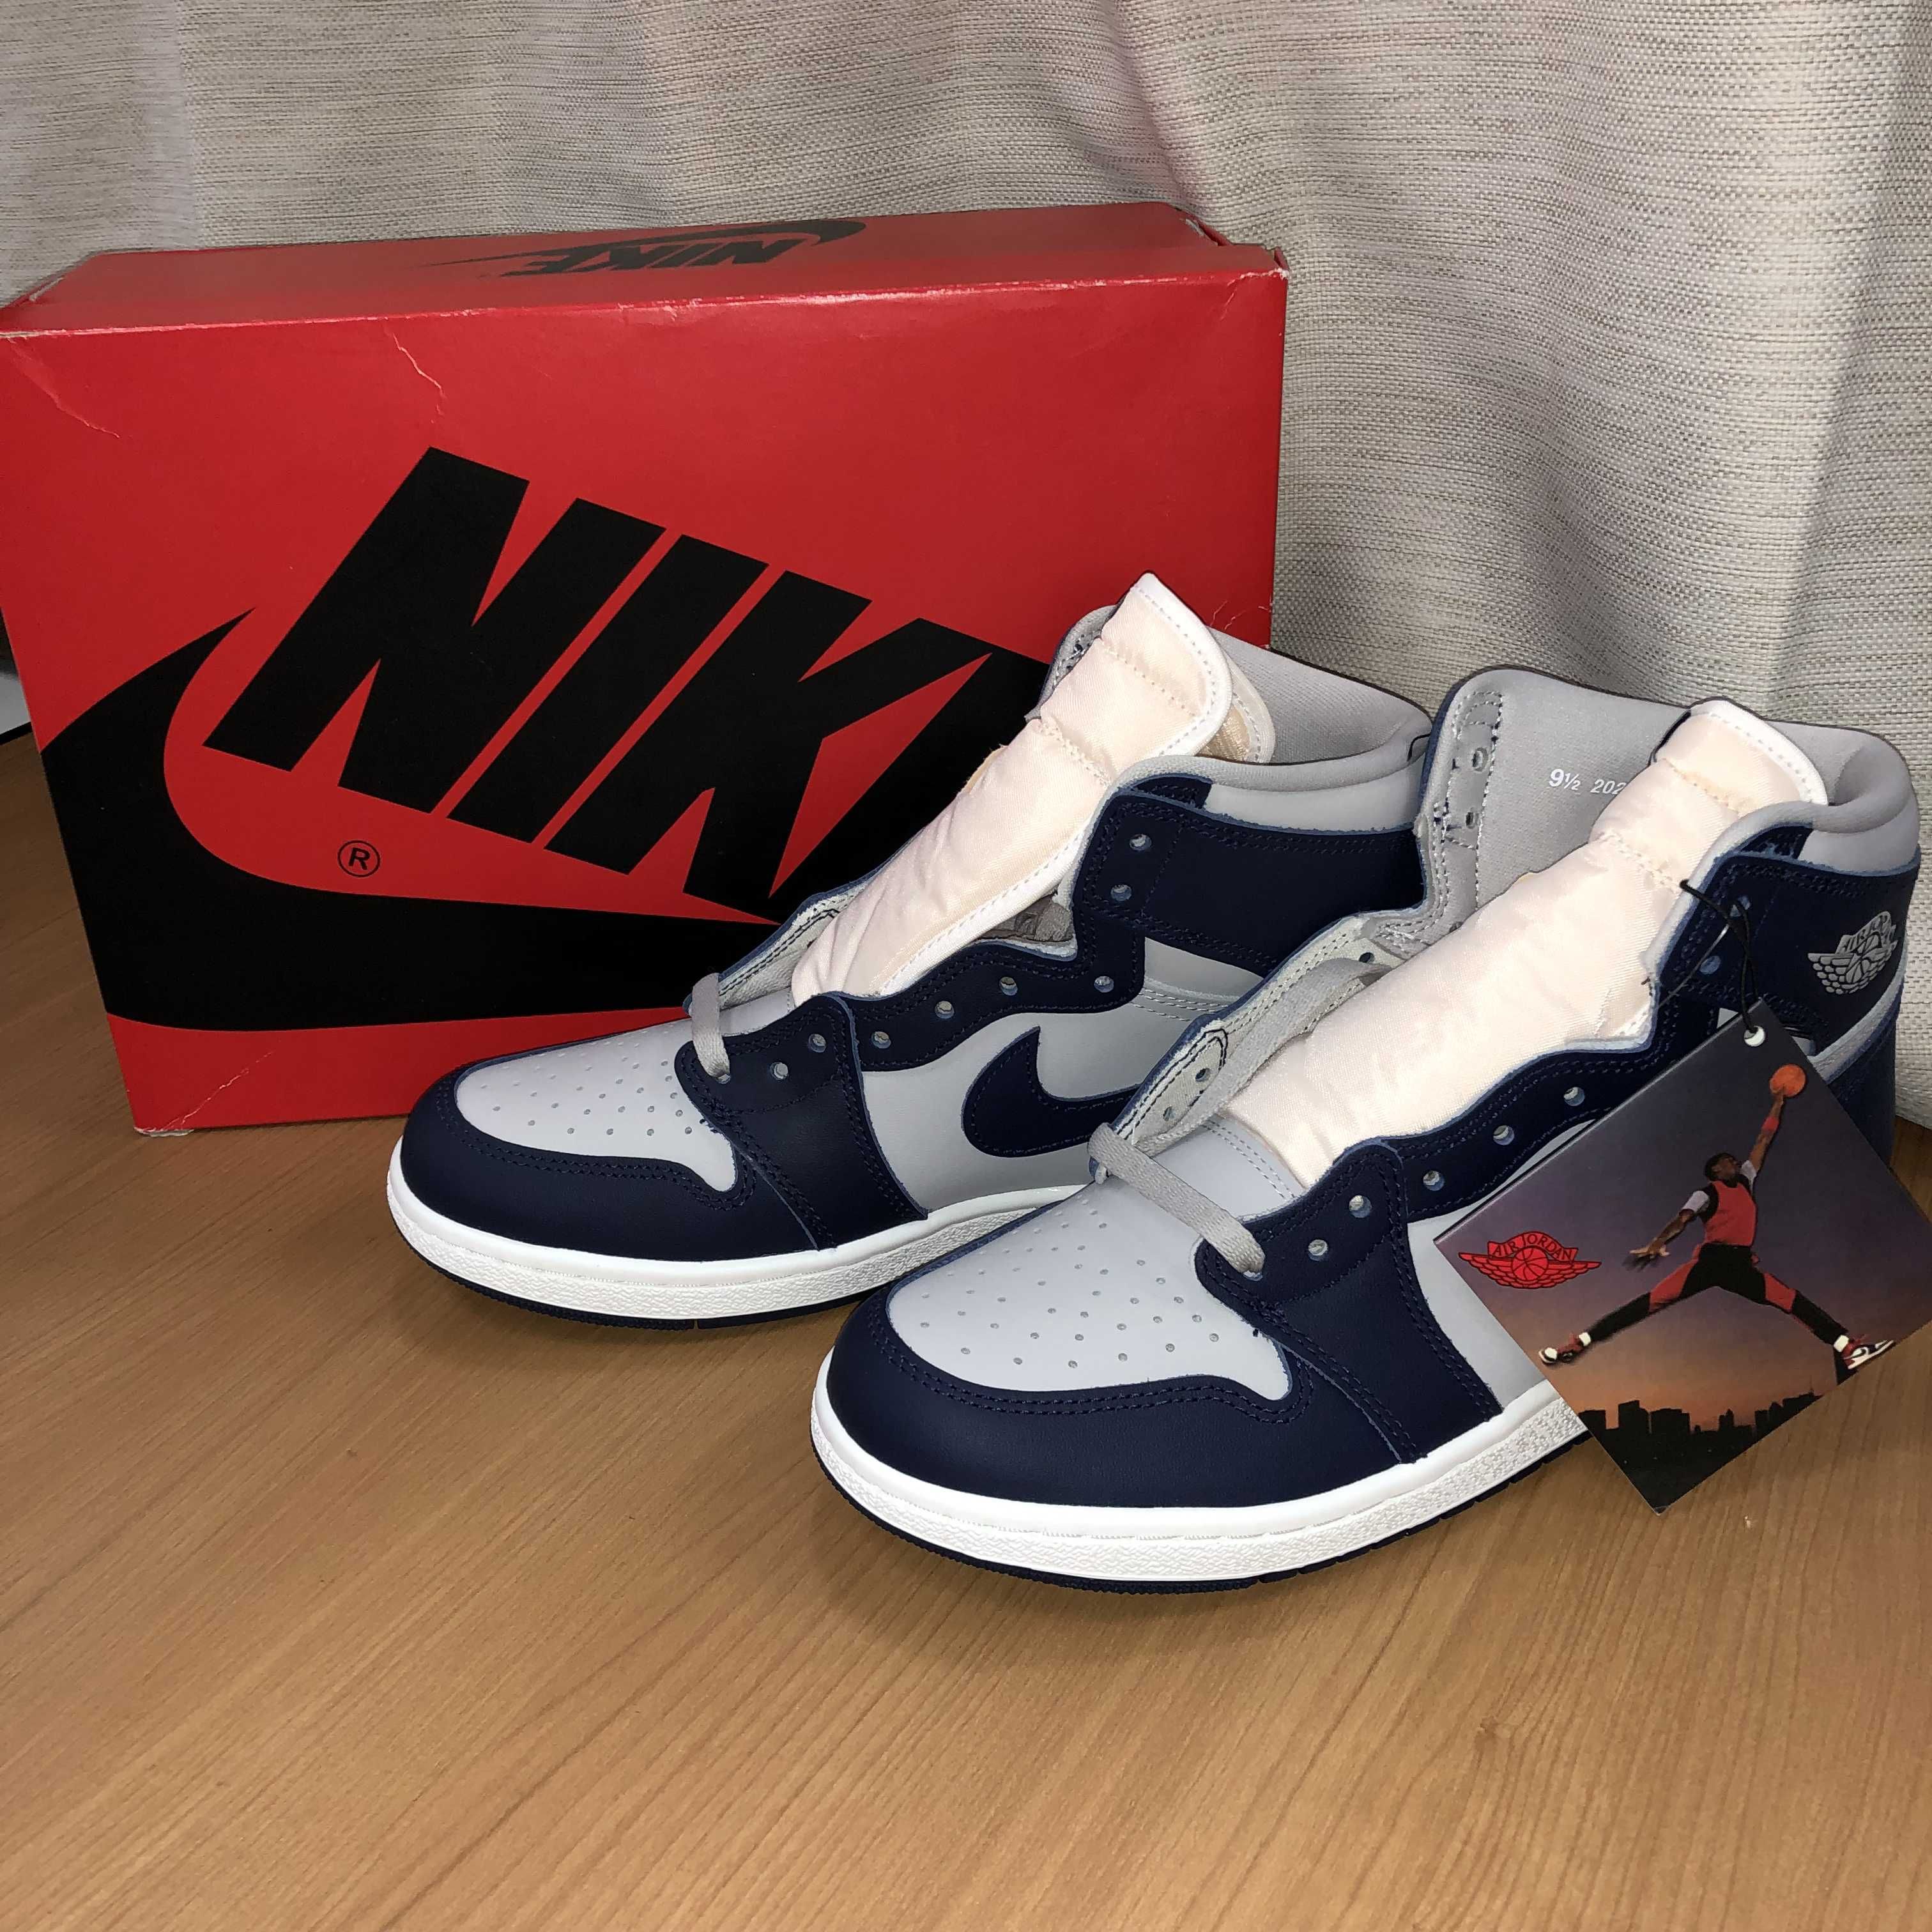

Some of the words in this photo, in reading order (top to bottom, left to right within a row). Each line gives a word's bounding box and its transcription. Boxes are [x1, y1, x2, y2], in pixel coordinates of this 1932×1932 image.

[501, 239, 808, 277] NIKE
[1492, 1241, 1519, 1256] AIR
[1521, 1234, 1573, 1260] JORDAN
